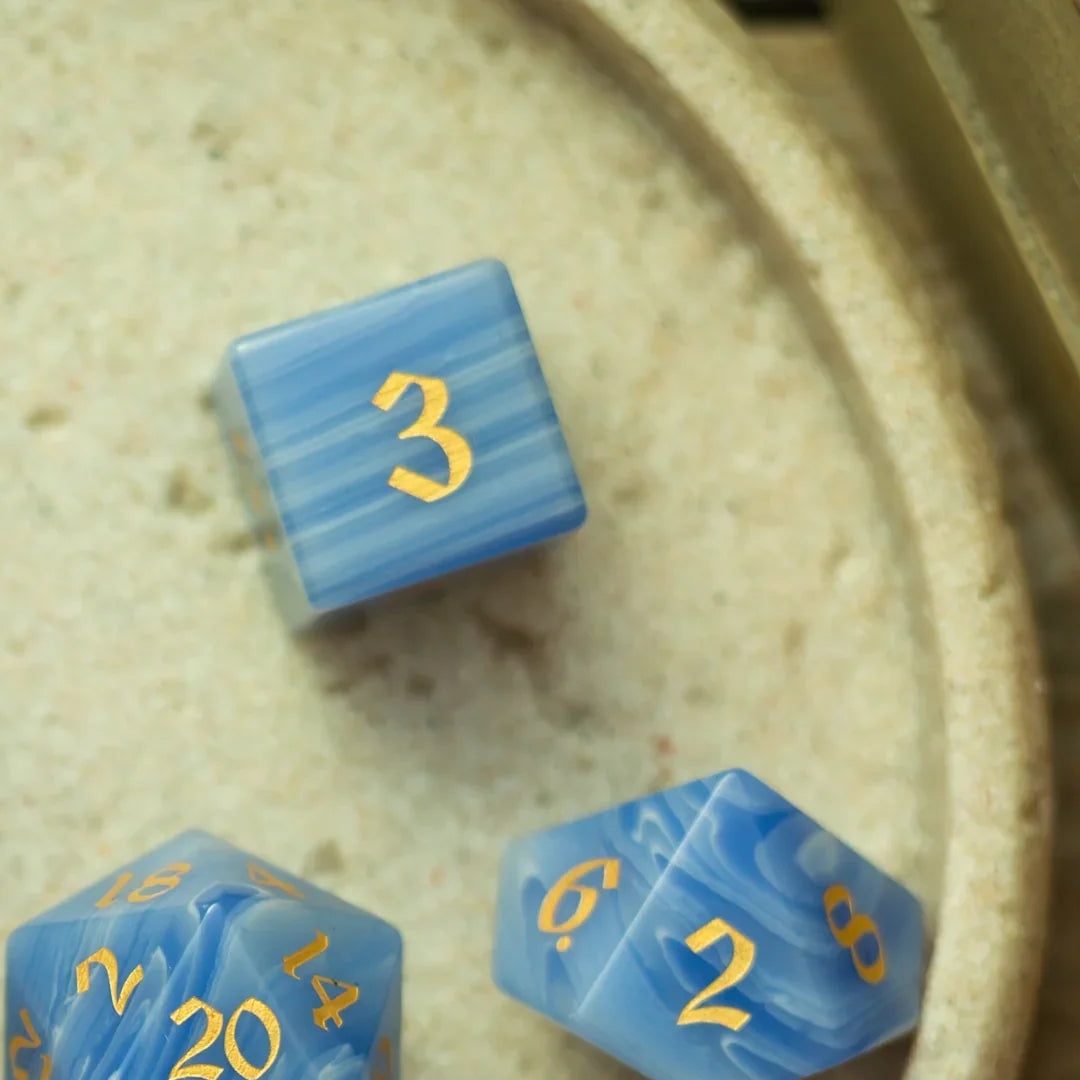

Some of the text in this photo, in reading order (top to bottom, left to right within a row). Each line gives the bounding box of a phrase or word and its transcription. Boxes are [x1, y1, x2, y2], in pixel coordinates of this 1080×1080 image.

[372, 371, 473, 503] 3
[94, 862, 191, 909] 18
[823, 884, 887, 985] 8
[75, 946, 144, 1016] 2
[282, 930, 360, 1031] 14
[676, 917, 756, 1031] 2
